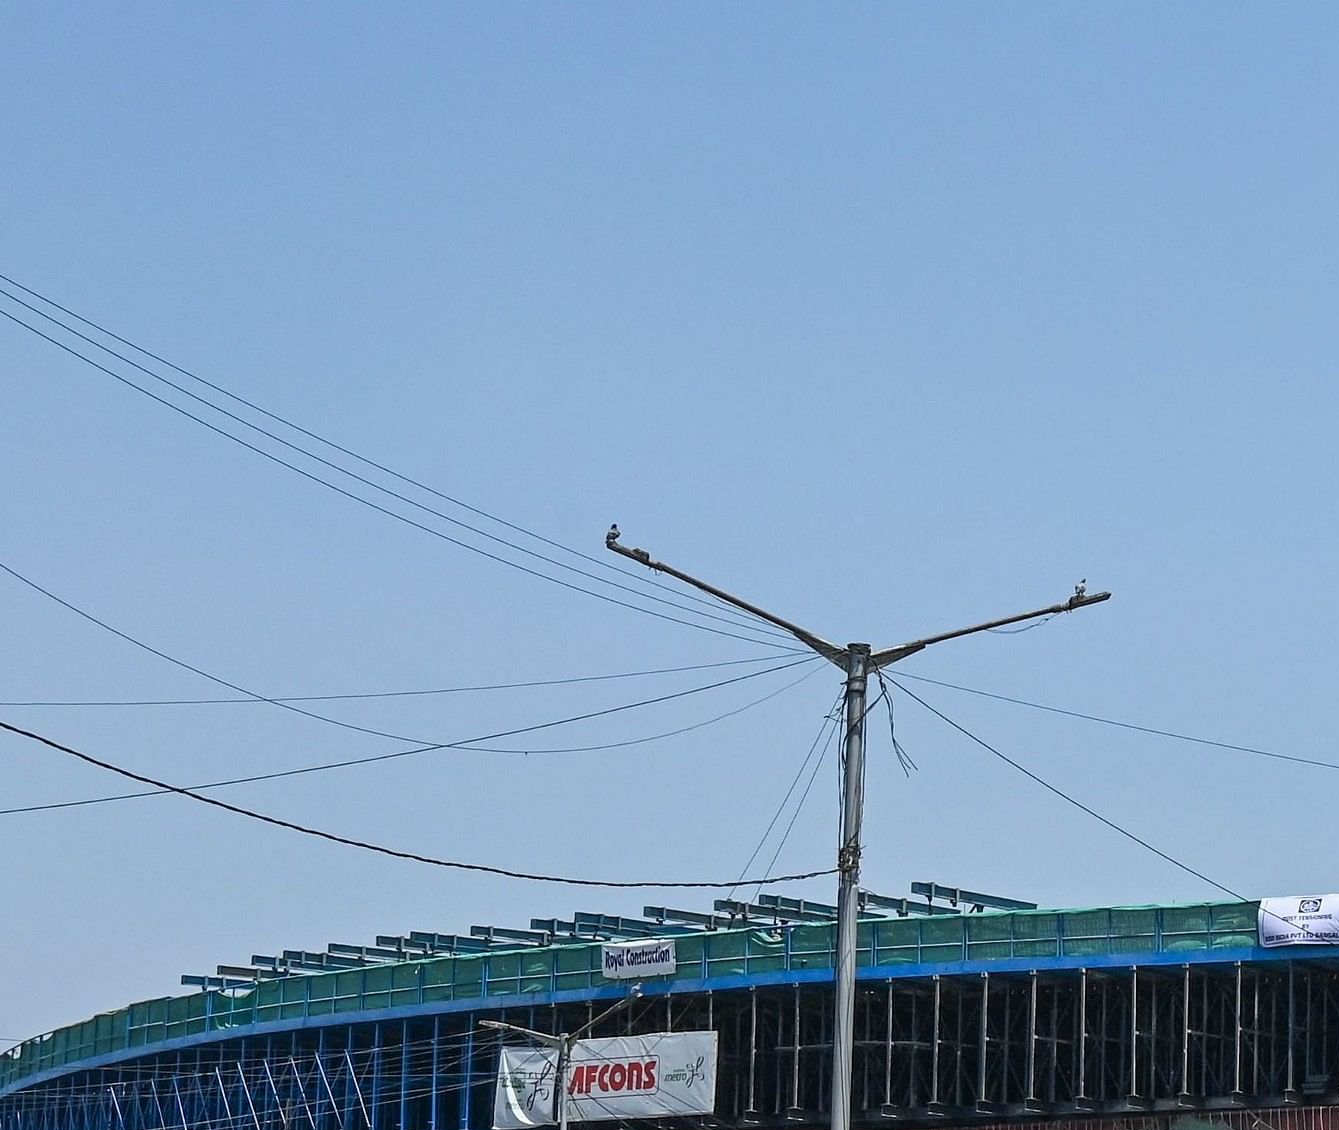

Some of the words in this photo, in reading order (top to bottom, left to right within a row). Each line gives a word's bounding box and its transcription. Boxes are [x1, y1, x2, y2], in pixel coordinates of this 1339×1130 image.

[605, 949, 625, 971] Royal
[626, 946, 670, 966] Construction
[568, 1060, 657, 1095] AFCONS
[664, 1072, 687, 1082] metro
